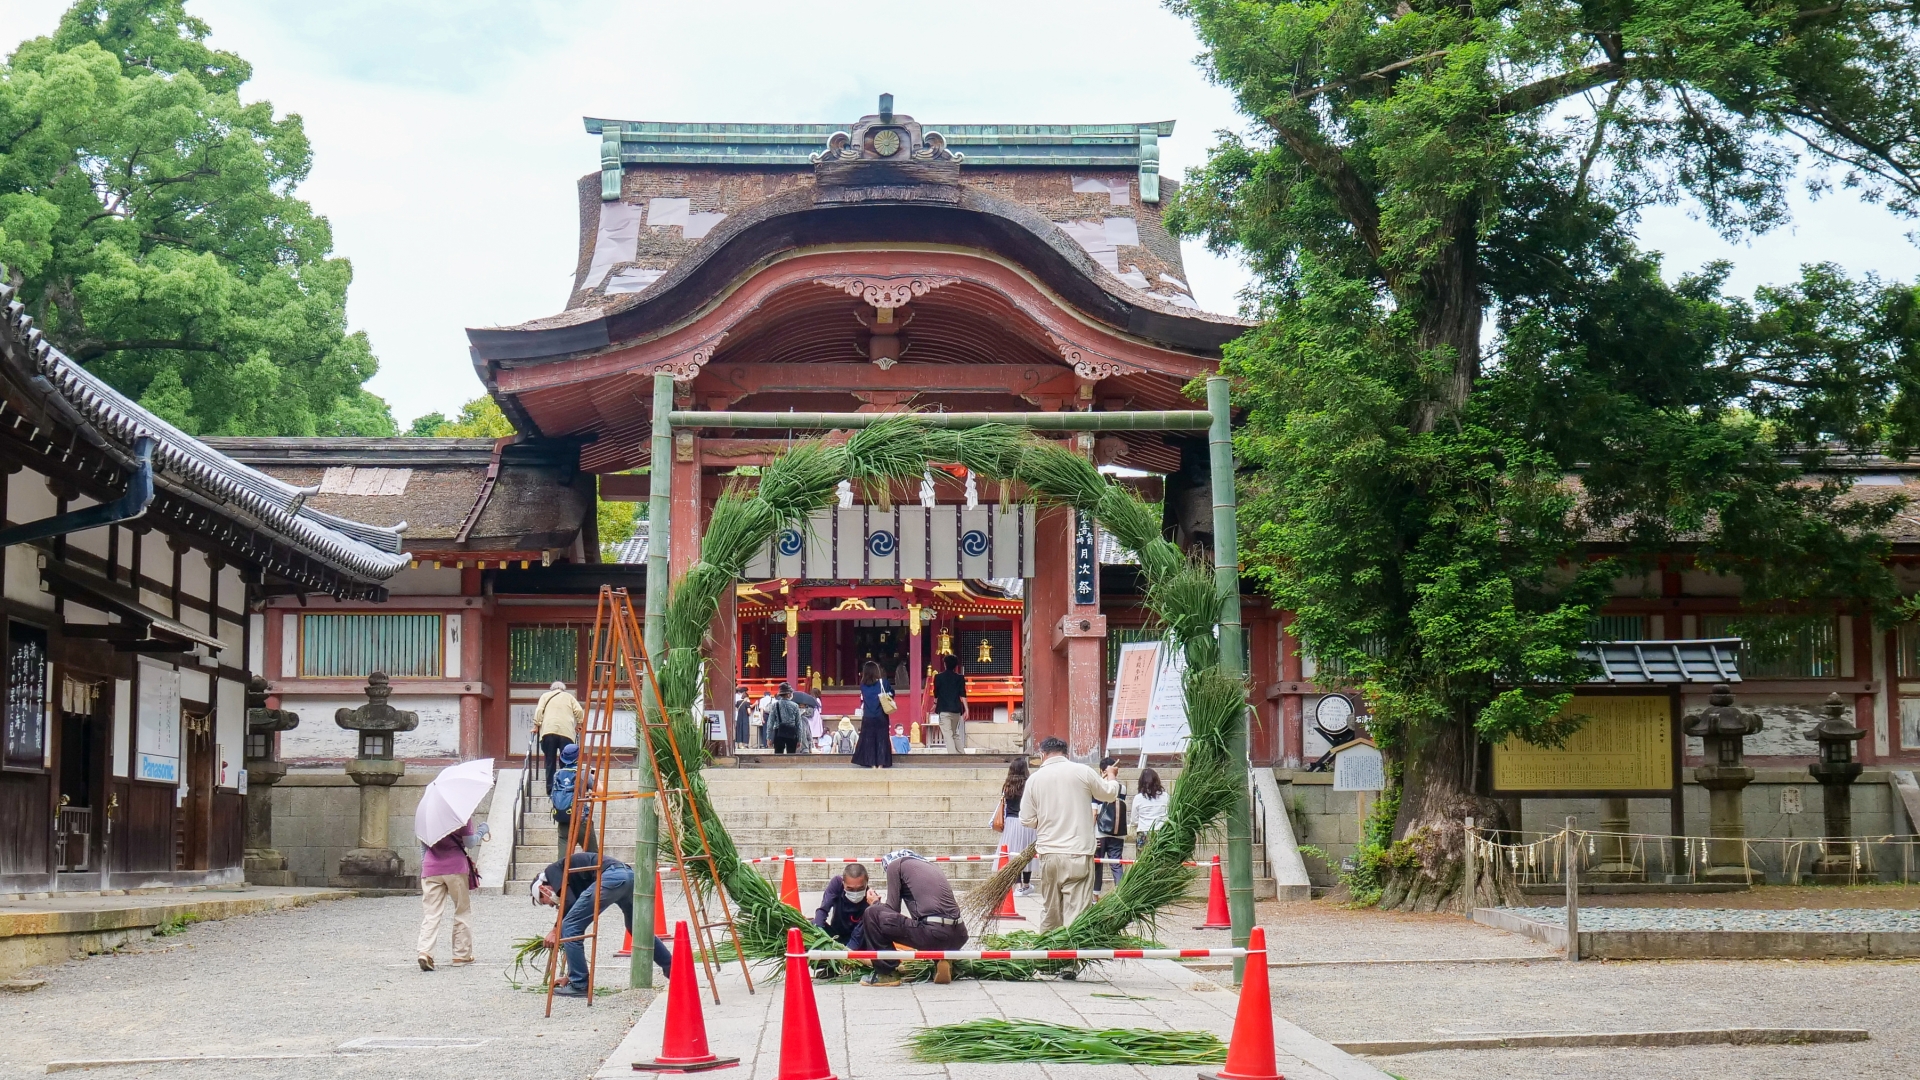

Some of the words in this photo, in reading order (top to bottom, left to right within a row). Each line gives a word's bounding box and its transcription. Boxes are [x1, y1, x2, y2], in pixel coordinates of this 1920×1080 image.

[1077, 548, 1092, 595] 月次祭
[143, 756, 174, 780] Panasonic
